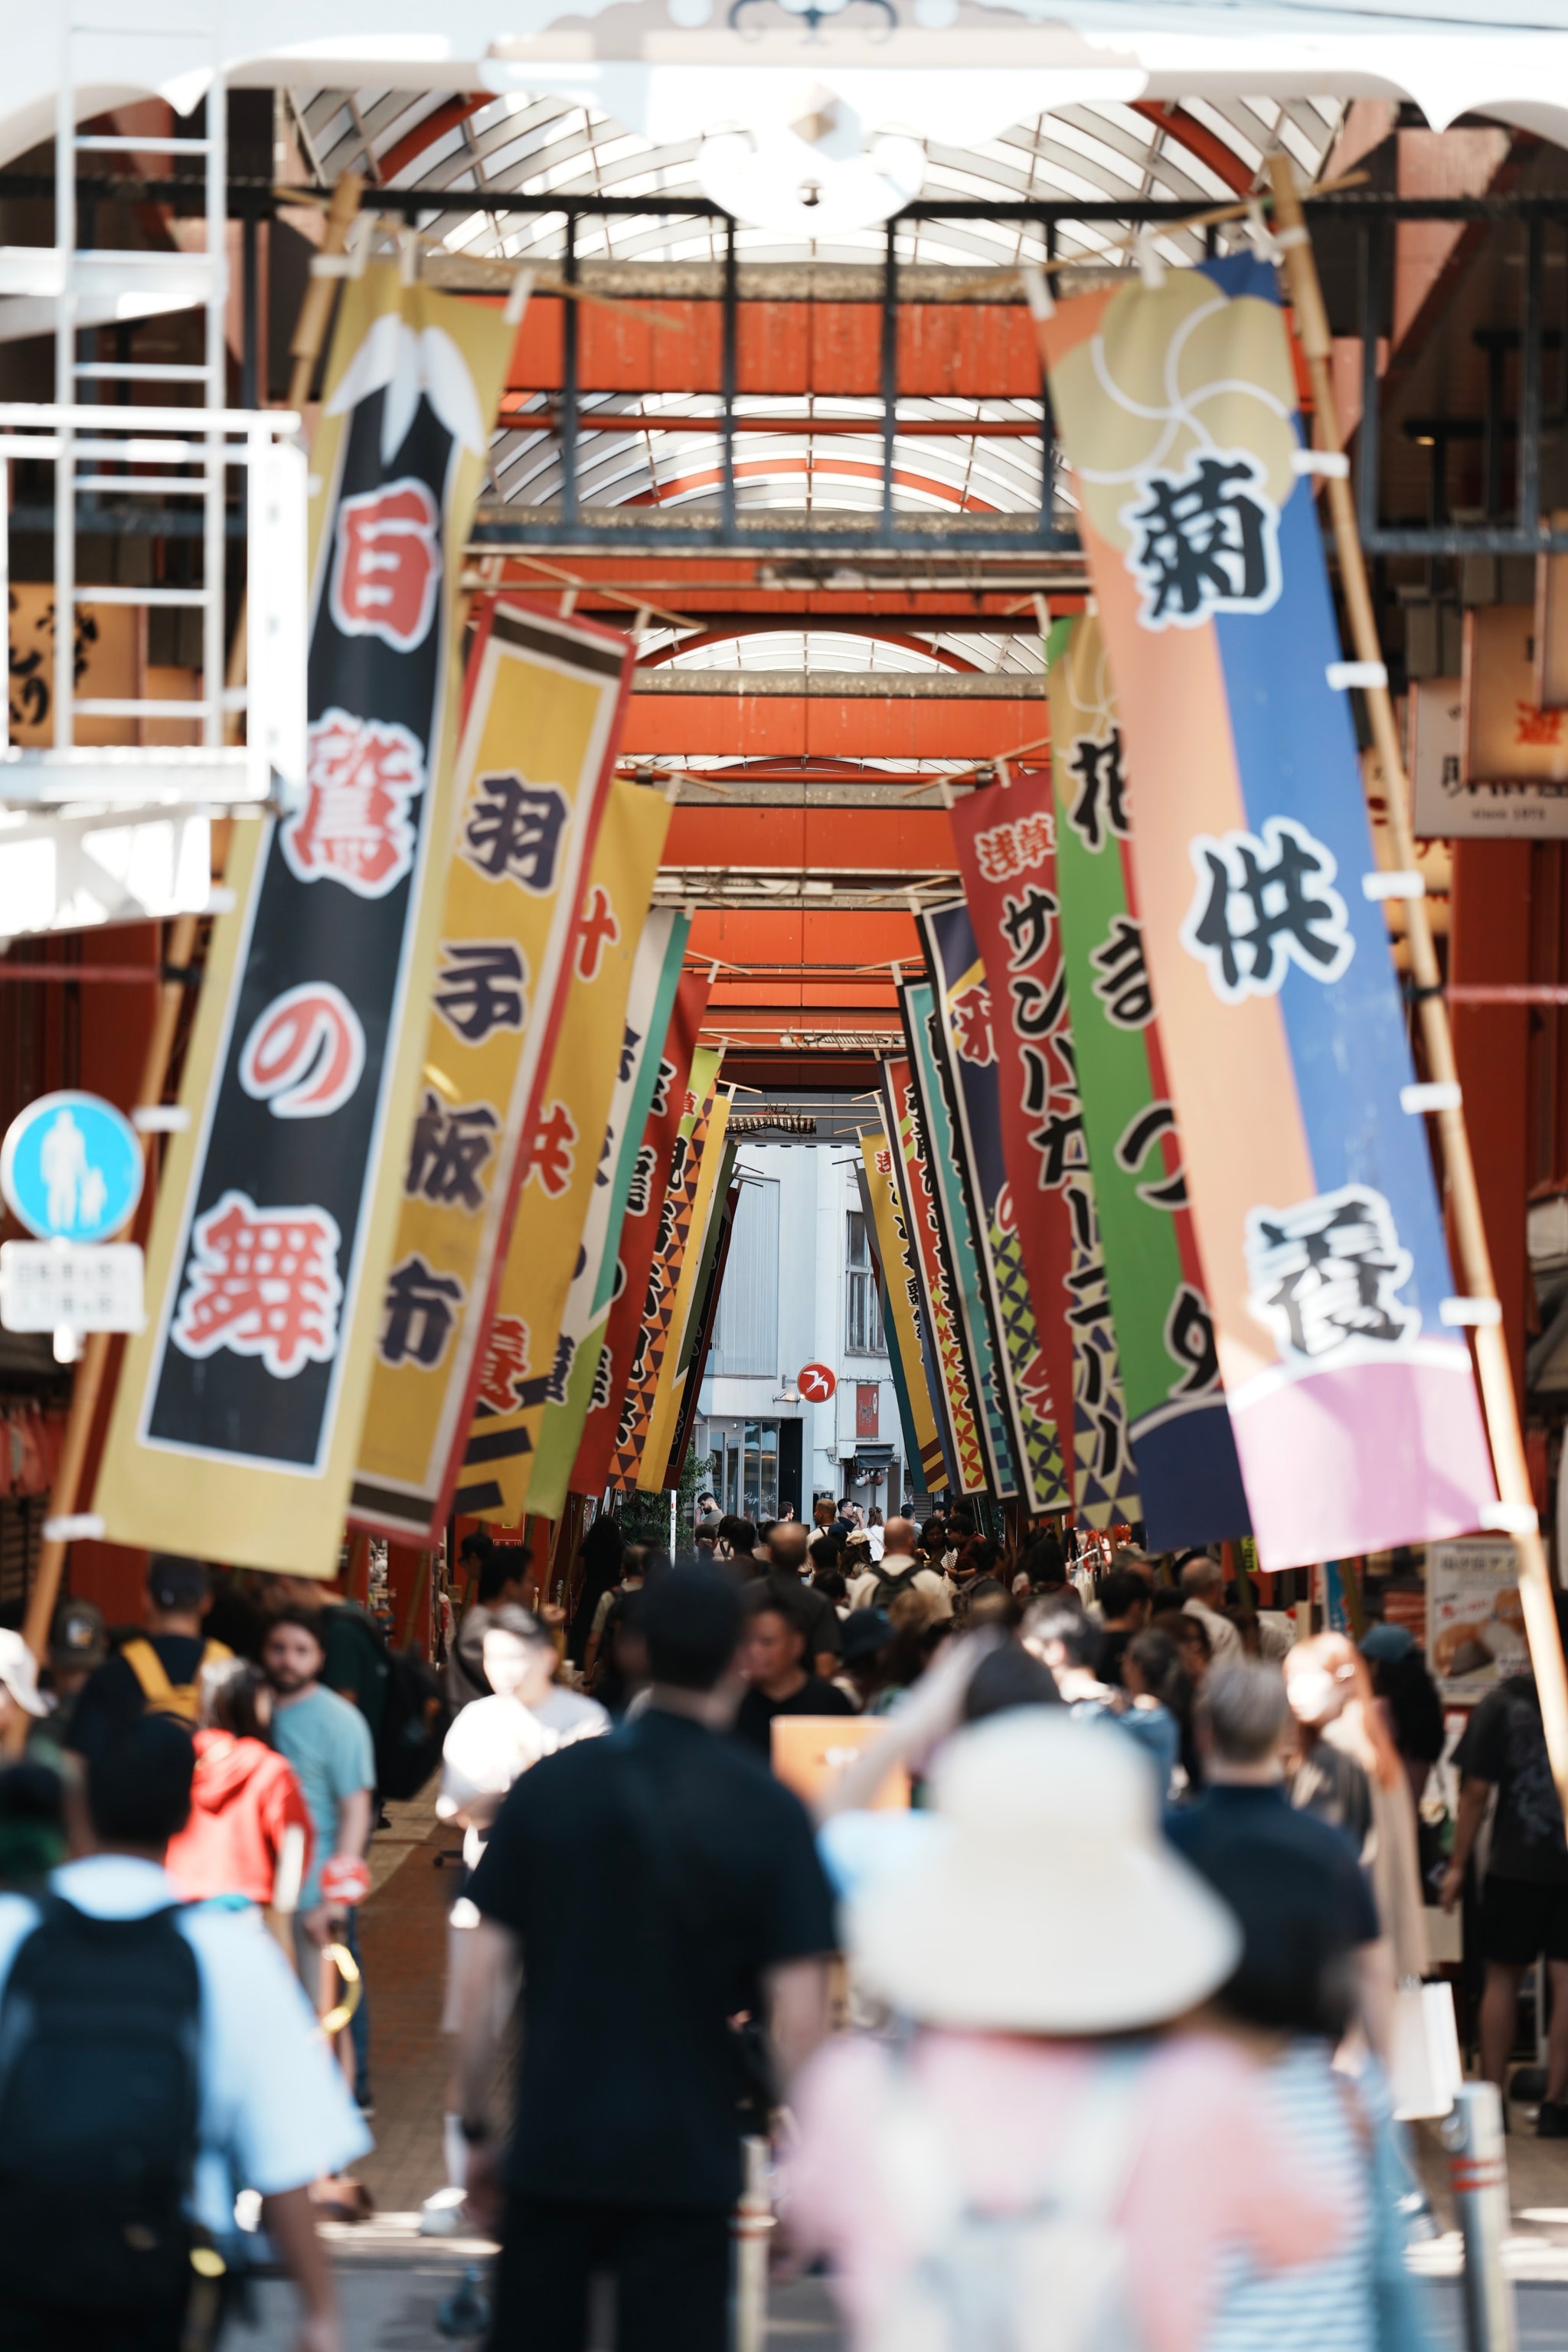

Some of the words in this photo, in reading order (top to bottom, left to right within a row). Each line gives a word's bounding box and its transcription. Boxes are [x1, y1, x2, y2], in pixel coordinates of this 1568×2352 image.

[173, 479, 438, 1377] 白鷺の舞
[378, 772, 570, 1370] 羽子板市
[974, 812, 1056, 883] 浅草
[1121, 449, 1421, 1367] 菊供養
